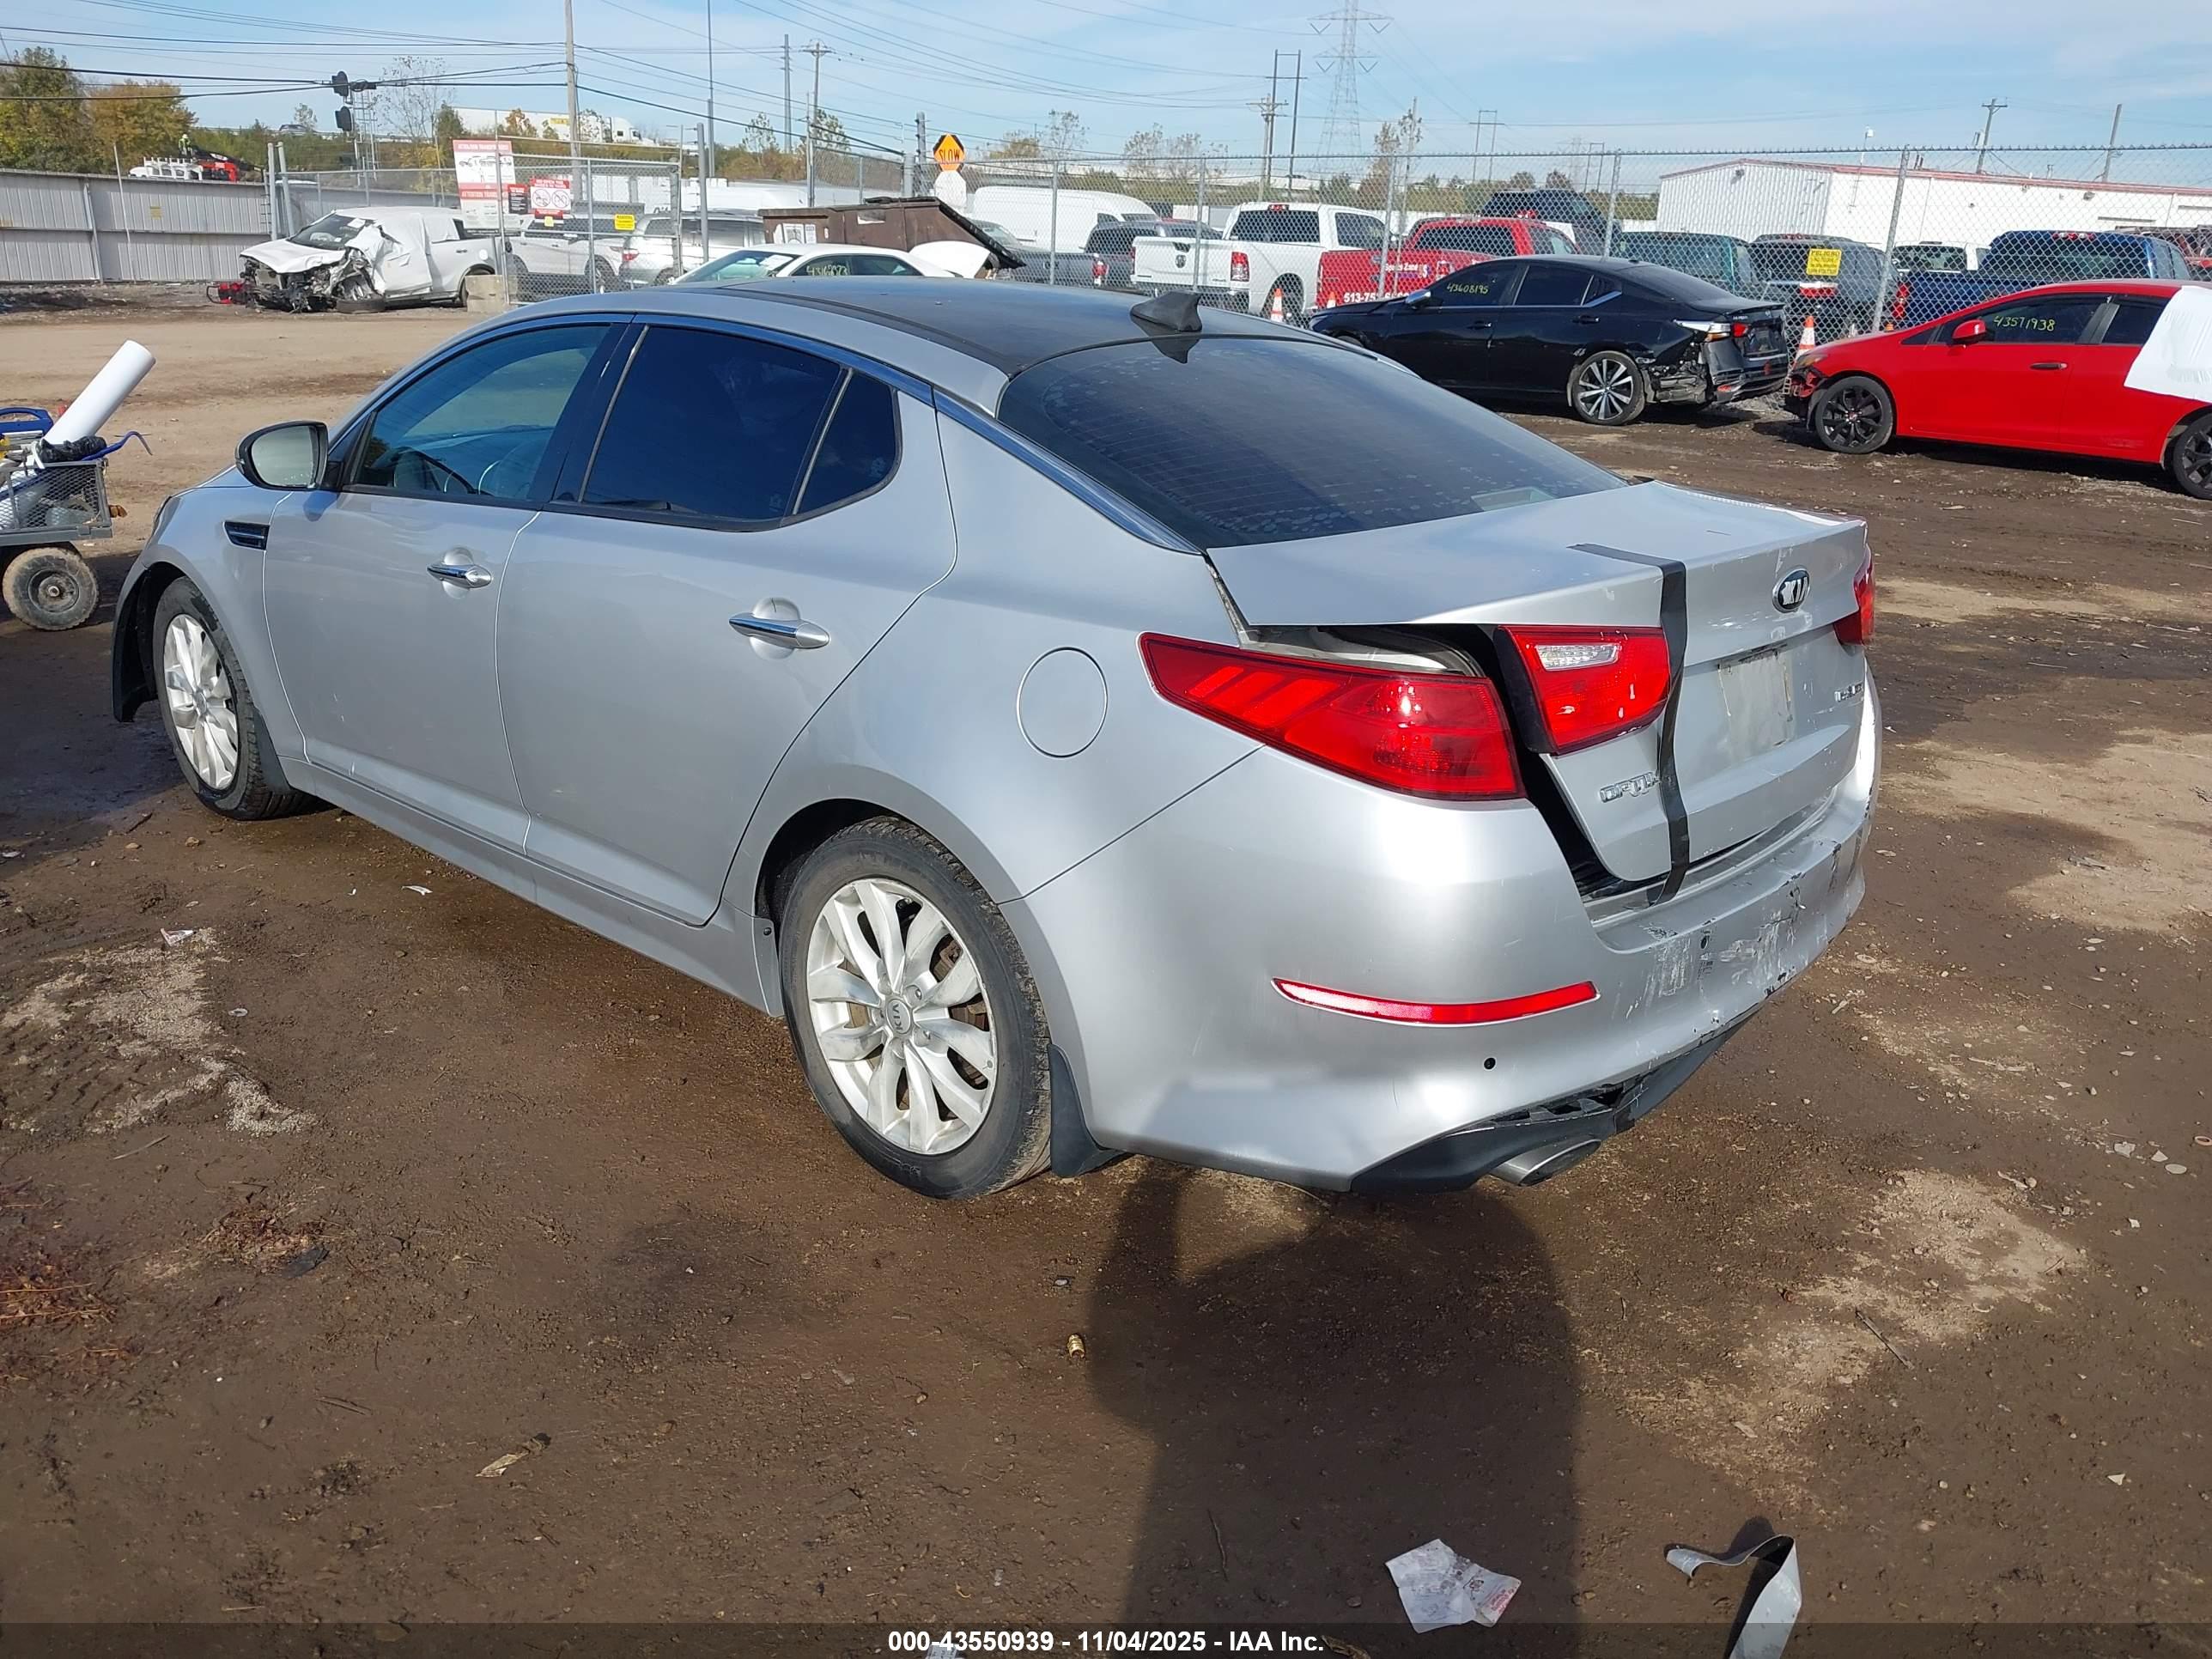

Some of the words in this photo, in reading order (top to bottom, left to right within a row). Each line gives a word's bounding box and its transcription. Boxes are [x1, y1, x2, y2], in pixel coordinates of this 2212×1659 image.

[938, 149, 960, 164] SLOW
[1446, 283, 1489, 295] 43608195
[1993, 315, 2057, 332] 43571938
[1781, 576, 1809, 605] KIA
